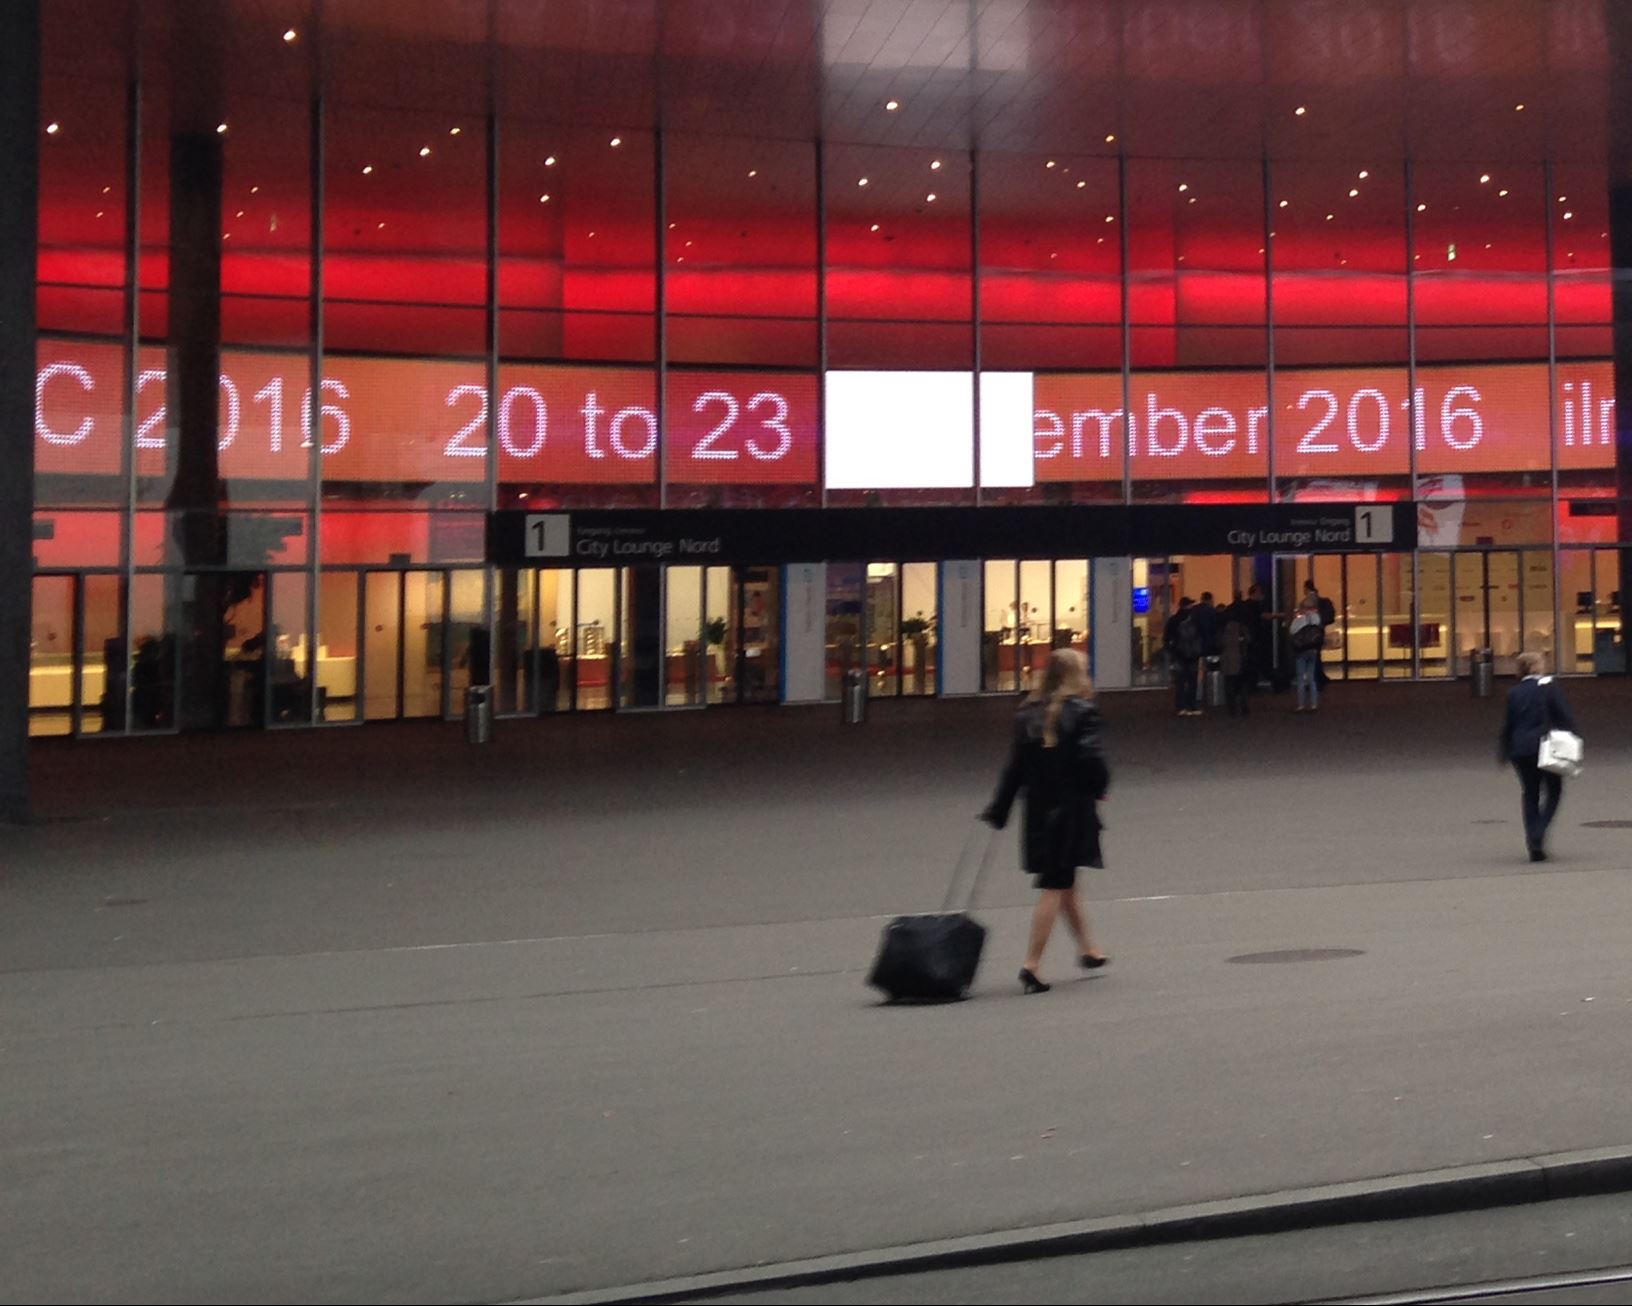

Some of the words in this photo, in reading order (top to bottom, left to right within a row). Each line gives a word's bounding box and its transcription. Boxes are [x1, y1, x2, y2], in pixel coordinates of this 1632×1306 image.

[444, 385, 548, 458] 20
[578, 390, 657, 459] to
[692, 392, 792, 460] 23
[1297, 386, 1485, 453] 2016
[532, 520, 545, 552] 1
[1227, 530, 1257, 547] City
[1259, 530, 1311, 547] Lounge
[1315, 528, 1350, 542] Nord
[1360, 511, 1372, 539] 1
[576, 538, 609, 558] City
[613, 539, 673, 557] Lounge
[679, 537, 720, 553] Nord
